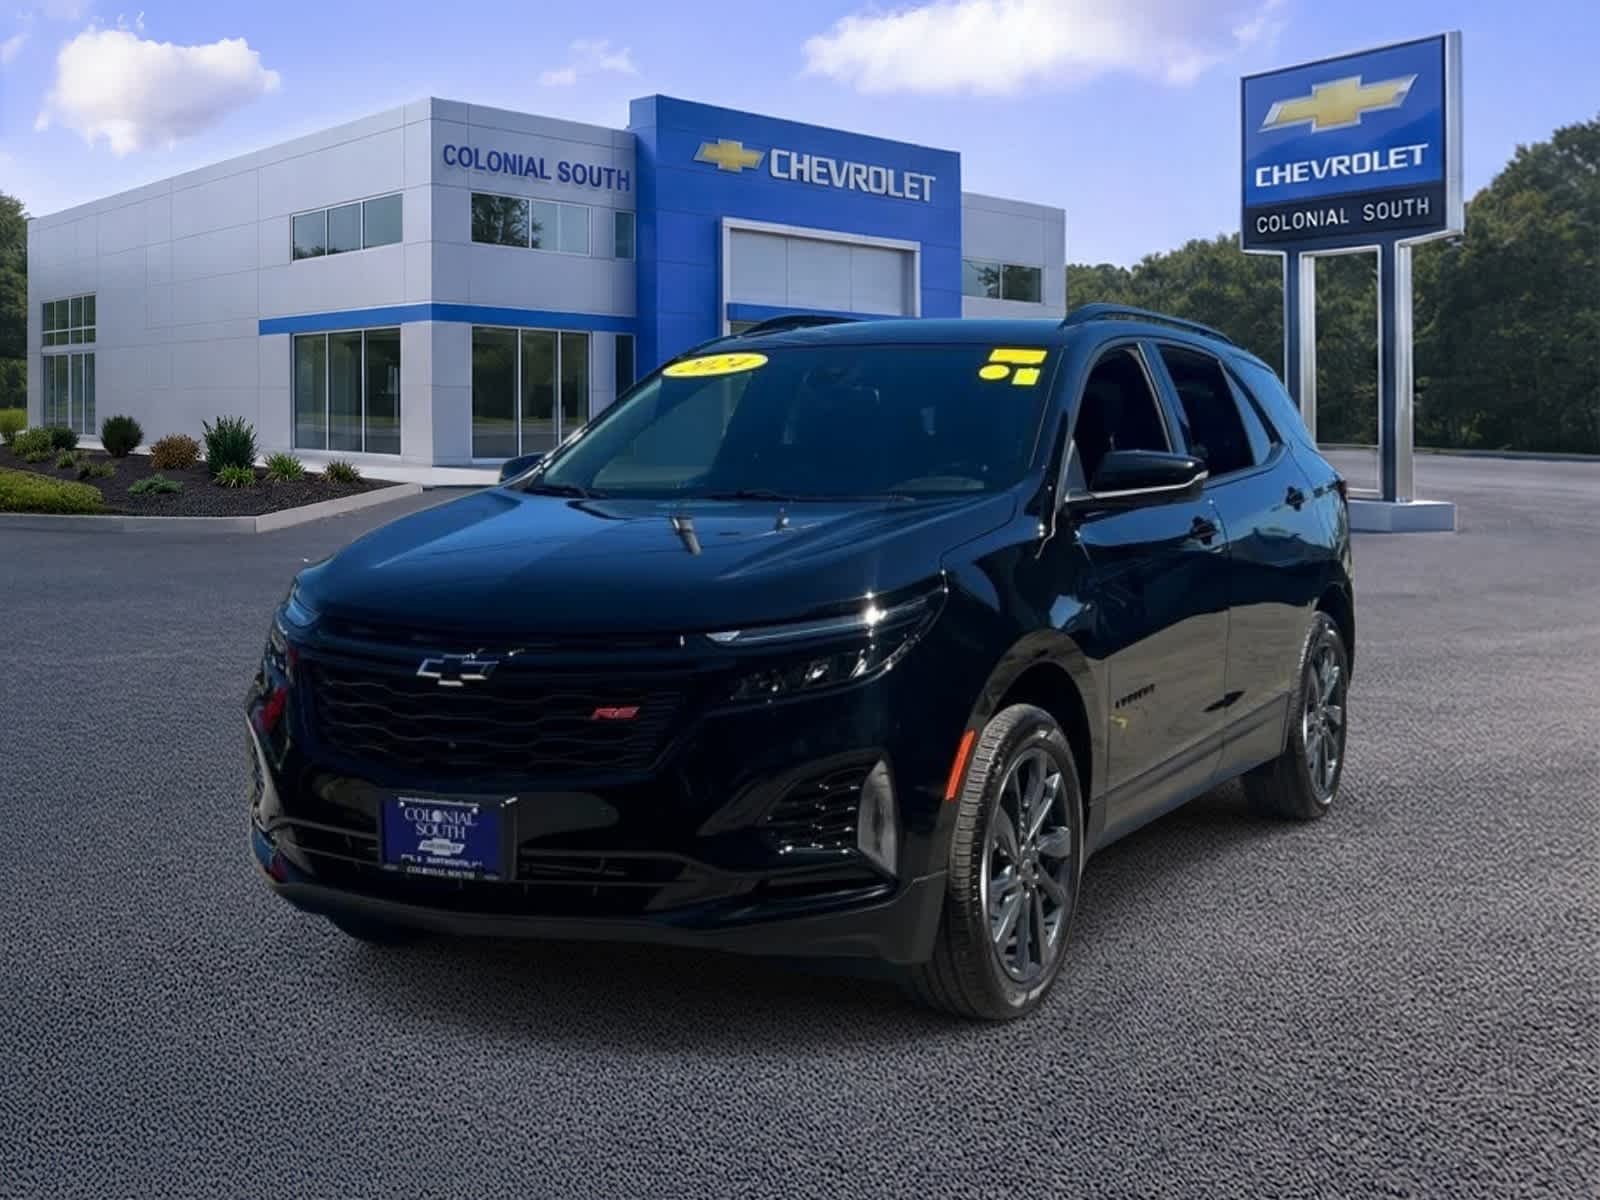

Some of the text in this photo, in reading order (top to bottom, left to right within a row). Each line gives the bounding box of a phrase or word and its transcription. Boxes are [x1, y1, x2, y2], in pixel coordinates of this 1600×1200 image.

[443, 144, 630, 192] COLONIAL SOUTH
[770, 148, 936, 202] CHEVROLET
[1255, 143, 1429, 188] CHEVROLET
[1256, 197, 1429, 234] COLONIAL SOUTH
[404, 806, 474, 826] COLONIAL
[415, 823, 465, 839] SOUTH
